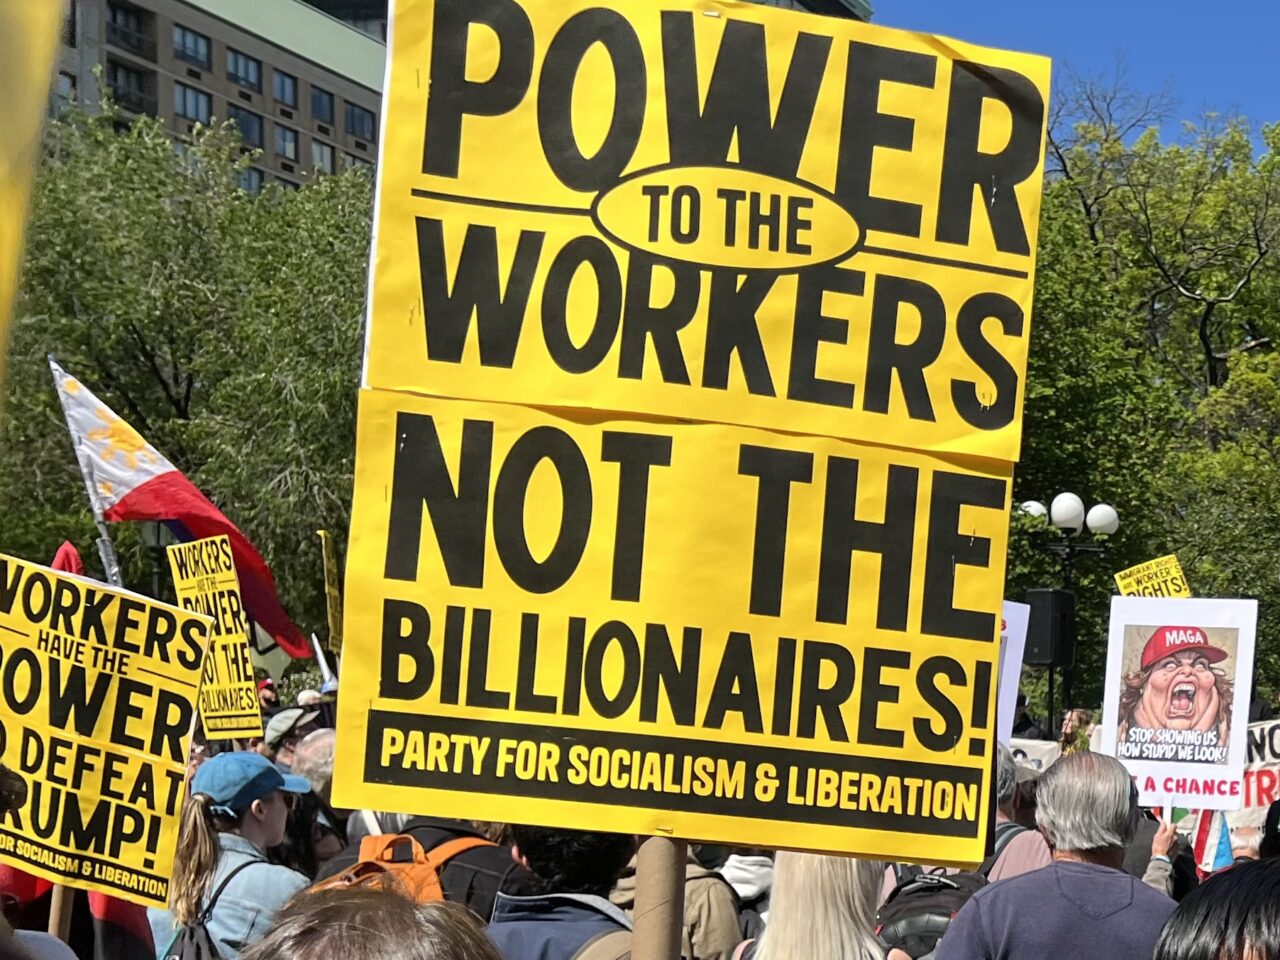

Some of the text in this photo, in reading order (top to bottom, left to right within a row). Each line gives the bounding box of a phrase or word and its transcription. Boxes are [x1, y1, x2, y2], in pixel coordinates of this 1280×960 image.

[422, 0, 1044, 256] POWER
[642, 185, 814, 255] TO THE
[415, 216, 1024, 431] WORKERS
[172, 538, 232, 580] WORKERS
[384, 411, 1007, 642] NOT THE
[38, 629, 131, 676] HAVE THE
[1165, 630, 1205, 647] MAGA
[0, 645, 194, 765] OWER
[378, 598, 993, 757] BILLIONAIRES!
[1117, 742, 1228, 762] HOW STUPID WE LOOK!
[1129, 727, 1218, 745] STOP SHOWING US
[20, 726, 184, 817] DEFEAT
[380, 728, 978, 822] PARTY FOR SOCIALISM & LIBERATION
[1144, 776, 1156, 792] A
[1163, 777, 1241, 797] CHANCE
[16, 838, 79, 873] SOCIALISM
[81, 862, 93, 877] &
[94, 863, 168, 898] LIBERATION
